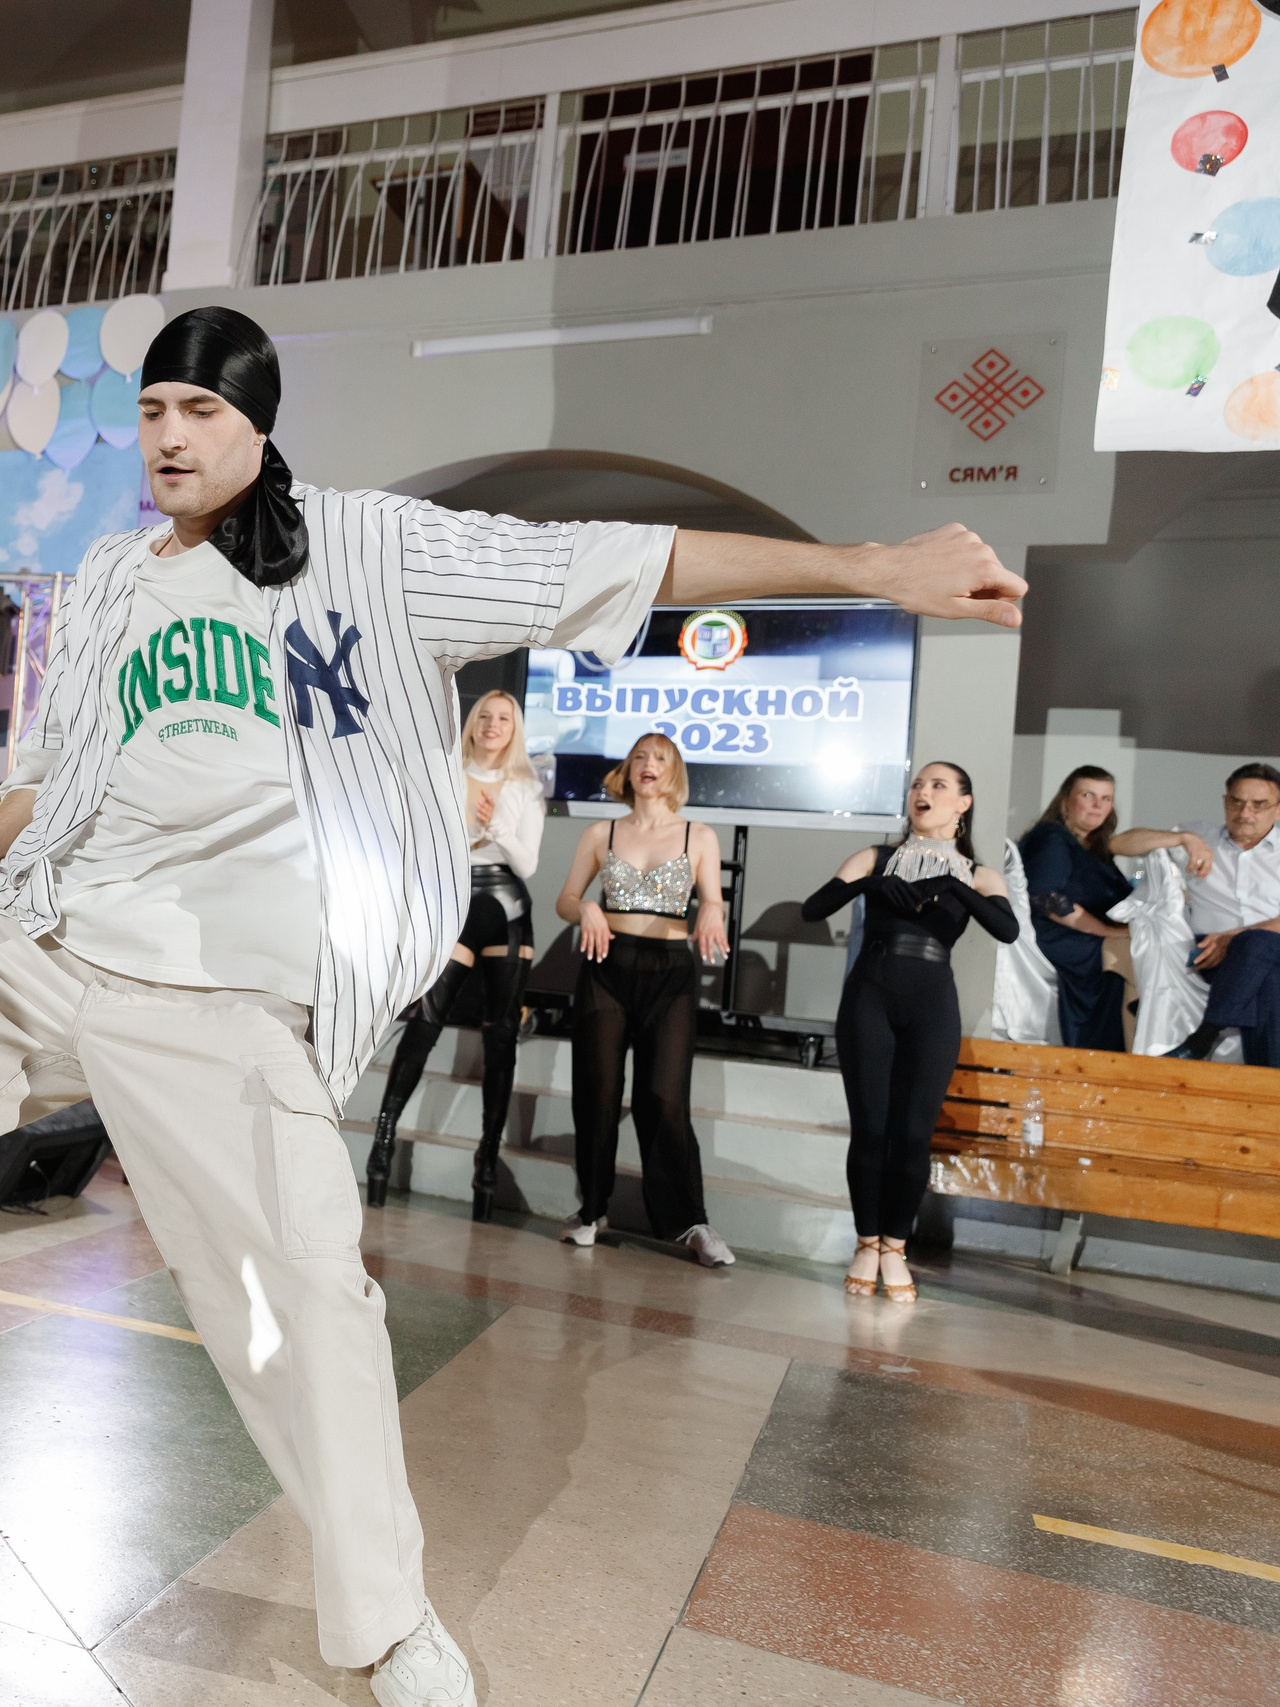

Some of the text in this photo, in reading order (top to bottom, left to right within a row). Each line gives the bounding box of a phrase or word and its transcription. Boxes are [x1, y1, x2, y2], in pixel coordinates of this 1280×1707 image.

[949, 464, 1018, 483] СЯМ'Я
[118, 617, 281, 746] INSIDE
[285, 609, 370, 739] NY
[554, 679, 862, 719] ВЫПУСКНОЙ
[158, 718, 238, 743] STREETWEAR
